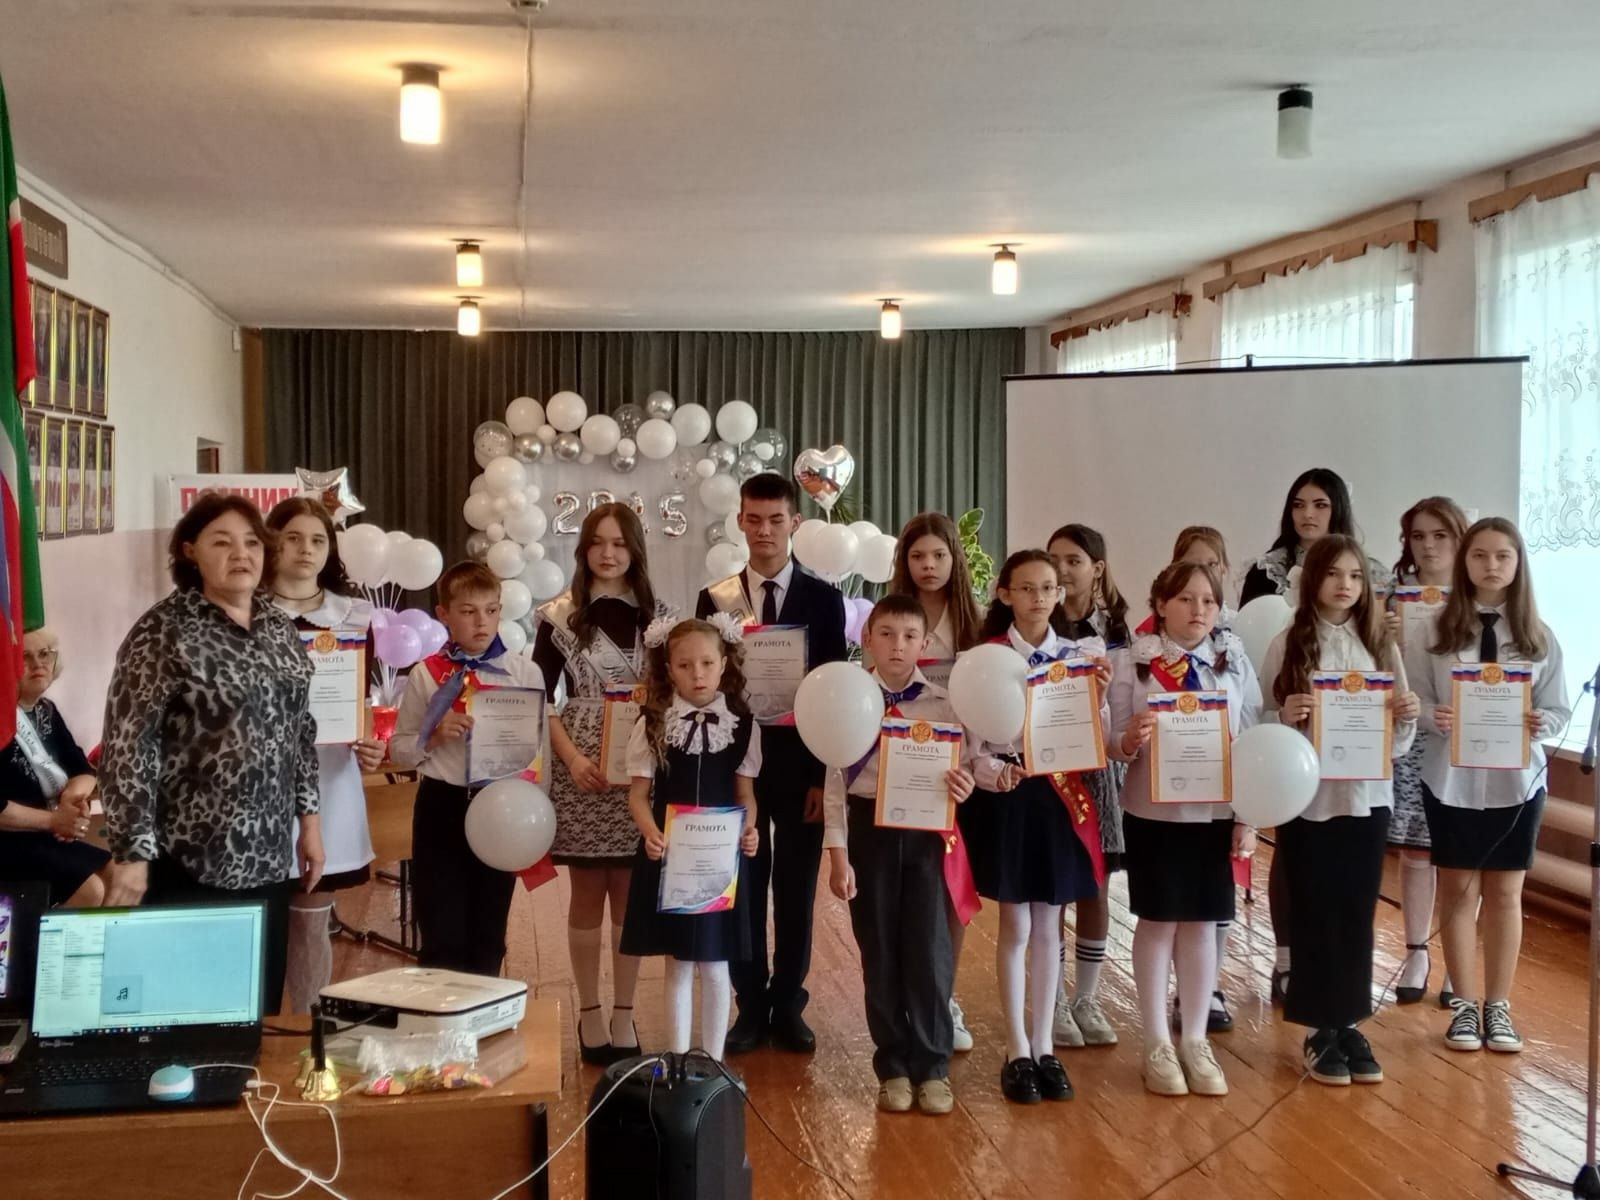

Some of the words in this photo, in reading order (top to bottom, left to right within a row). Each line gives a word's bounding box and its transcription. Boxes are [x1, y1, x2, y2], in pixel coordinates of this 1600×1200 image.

[753, 639, 792, 648] ГРАМОТА
[1042, 683, 1077, 695] ГРАМОТА
[1474, 686, 1511, 694] ГРАМОТА
[485, 696, 526, 705] ГРАМОТА
[1335, 695, 1373, 703] ГРАМОТА
[1172, 716, 1209, 724] ГРАМОТА
[902, 744, 940, 754] ГРАМОТА
[685, 823, 727, 833] ГРАМОТА
